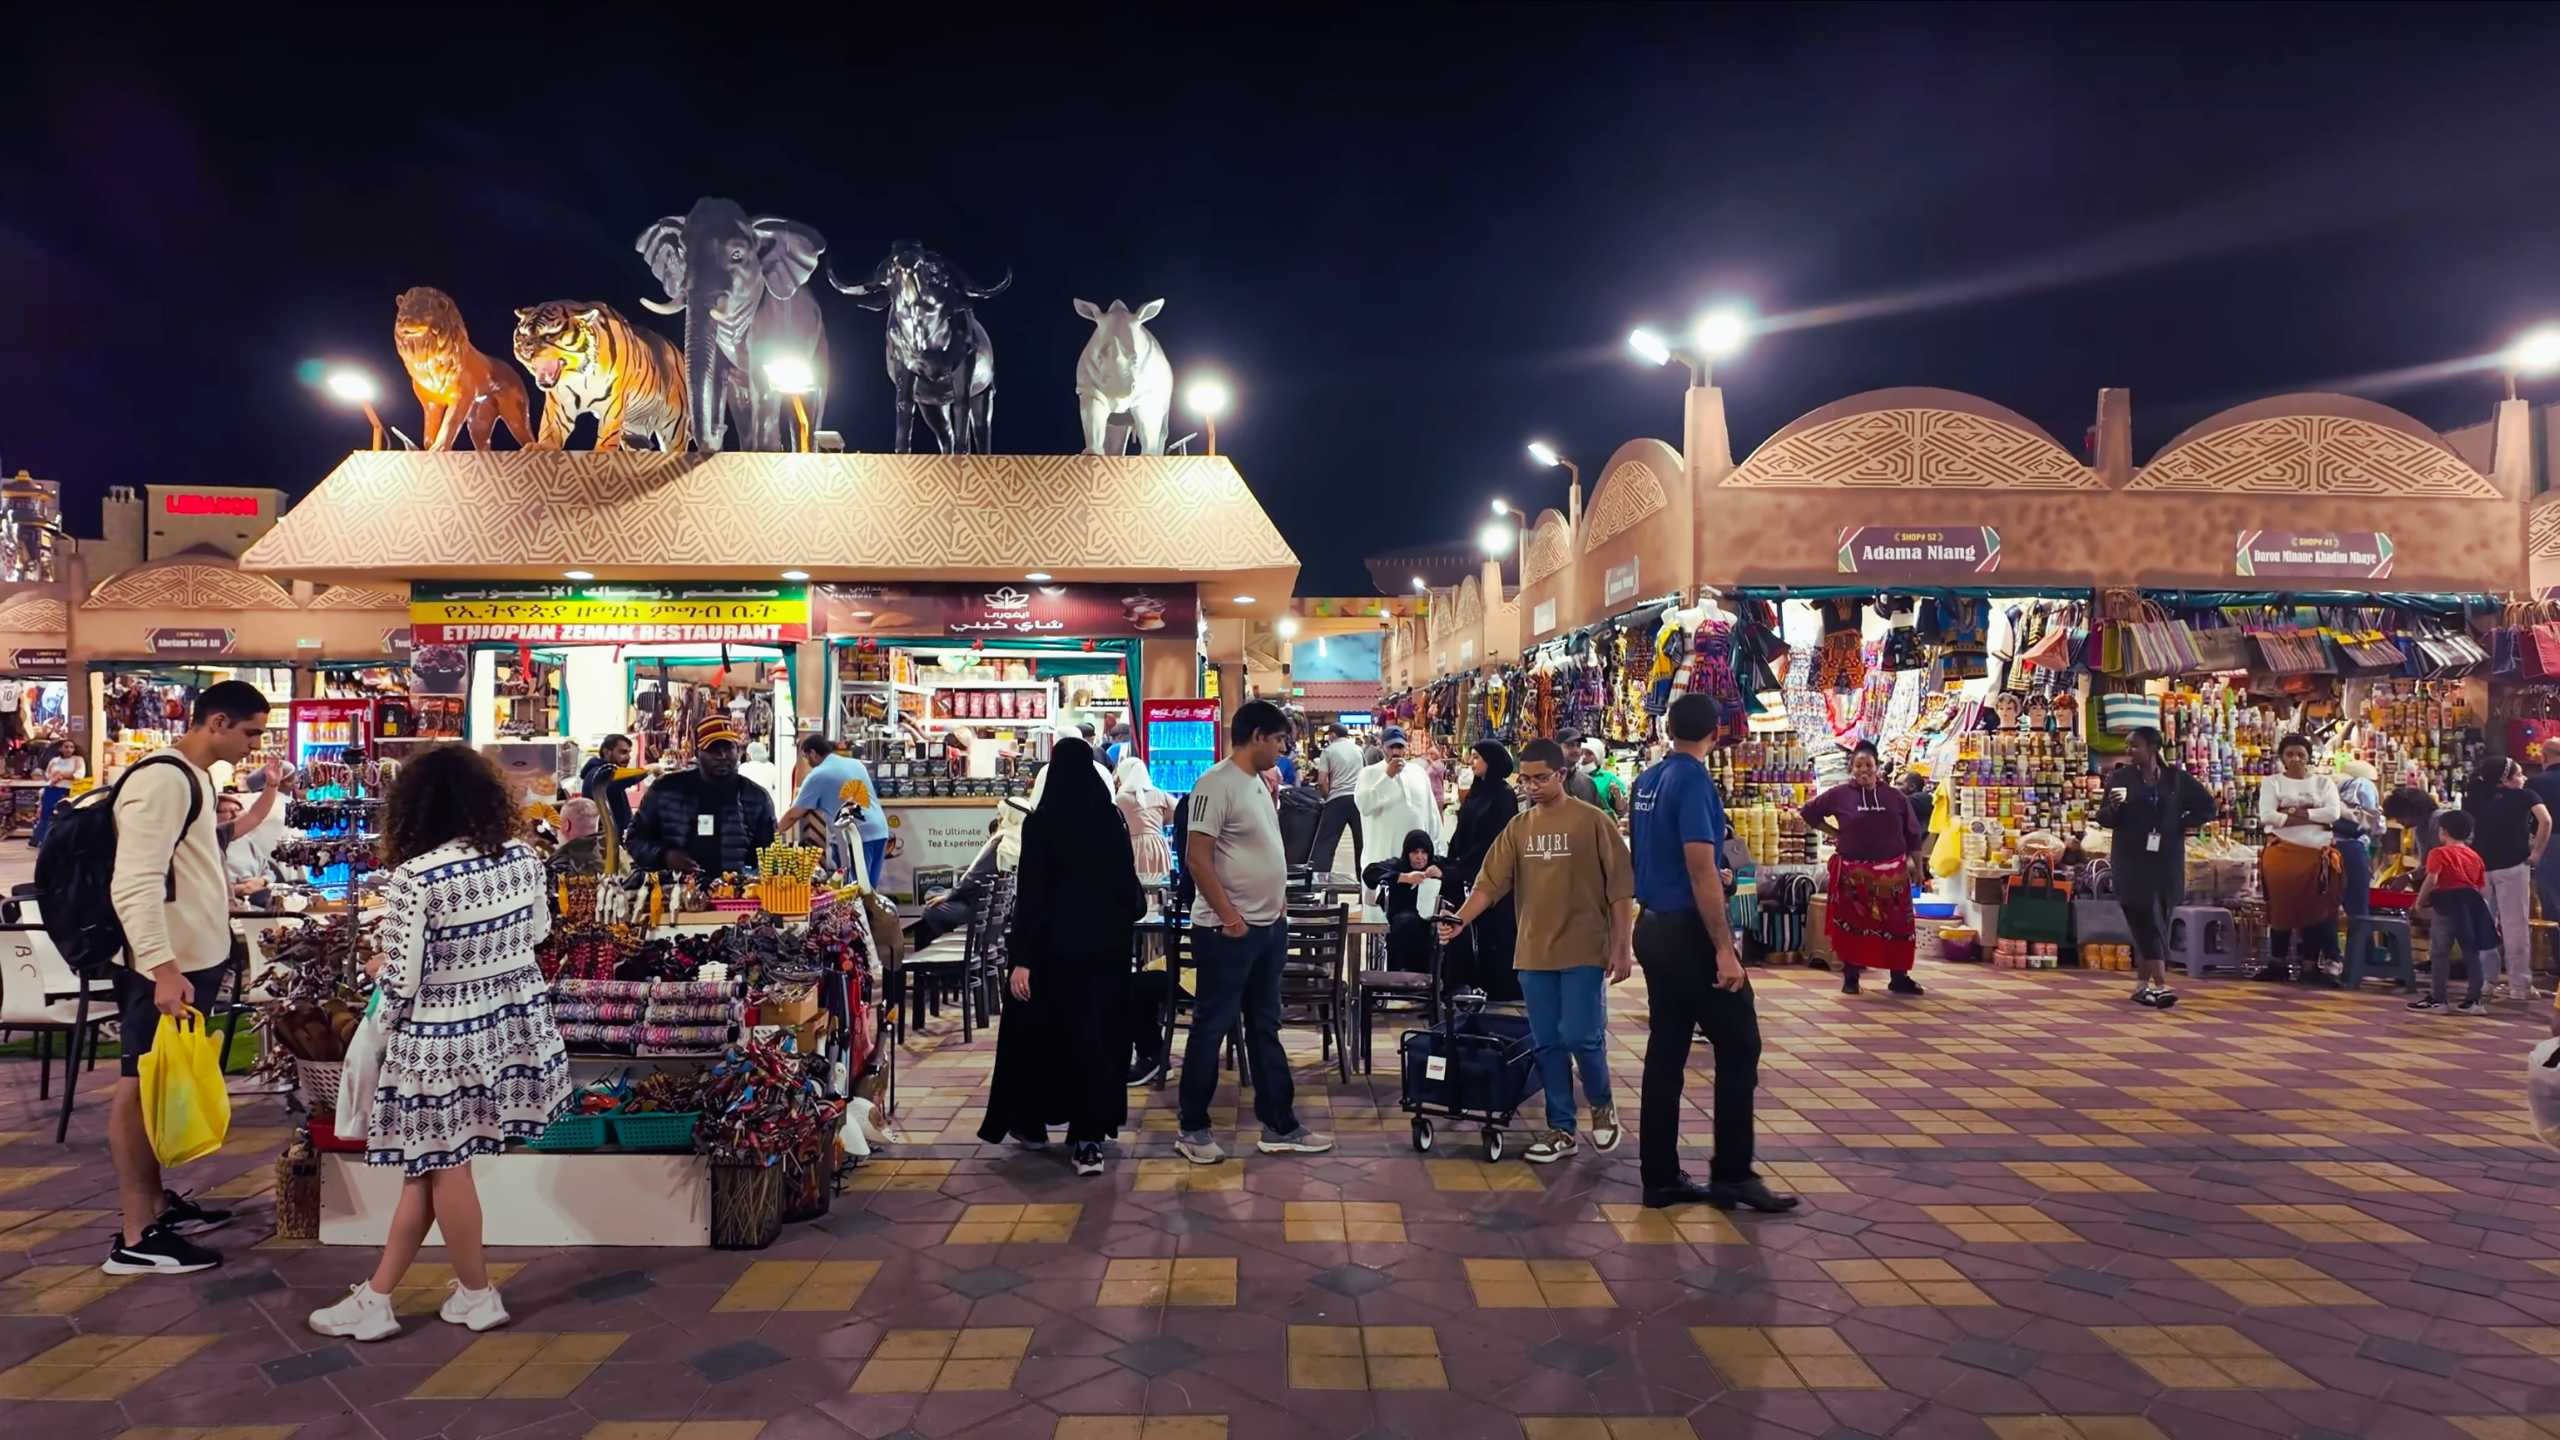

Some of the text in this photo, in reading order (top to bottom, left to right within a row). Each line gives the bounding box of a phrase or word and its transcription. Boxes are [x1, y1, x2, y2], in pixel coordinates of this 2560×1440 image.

[166, 495, 258, 516] LEBANON
[1927, 533, 1937, 541] 52
[1862, 544, 1976, 562] Adama Niang
[2254, 550, 2281, 562] Darou
[2315, 551, 2348, 564] Khadim
[2349, 551, 2377, 566] Mbaye
[443, 624, 782, 641] ETHIOPIAN ZEMAK RESTAURANT
[928, 828, 981, 836] The Ultimate
[928, 840, 942, 848] Tea
[1527, 833, 1568, 851] AMIRI
